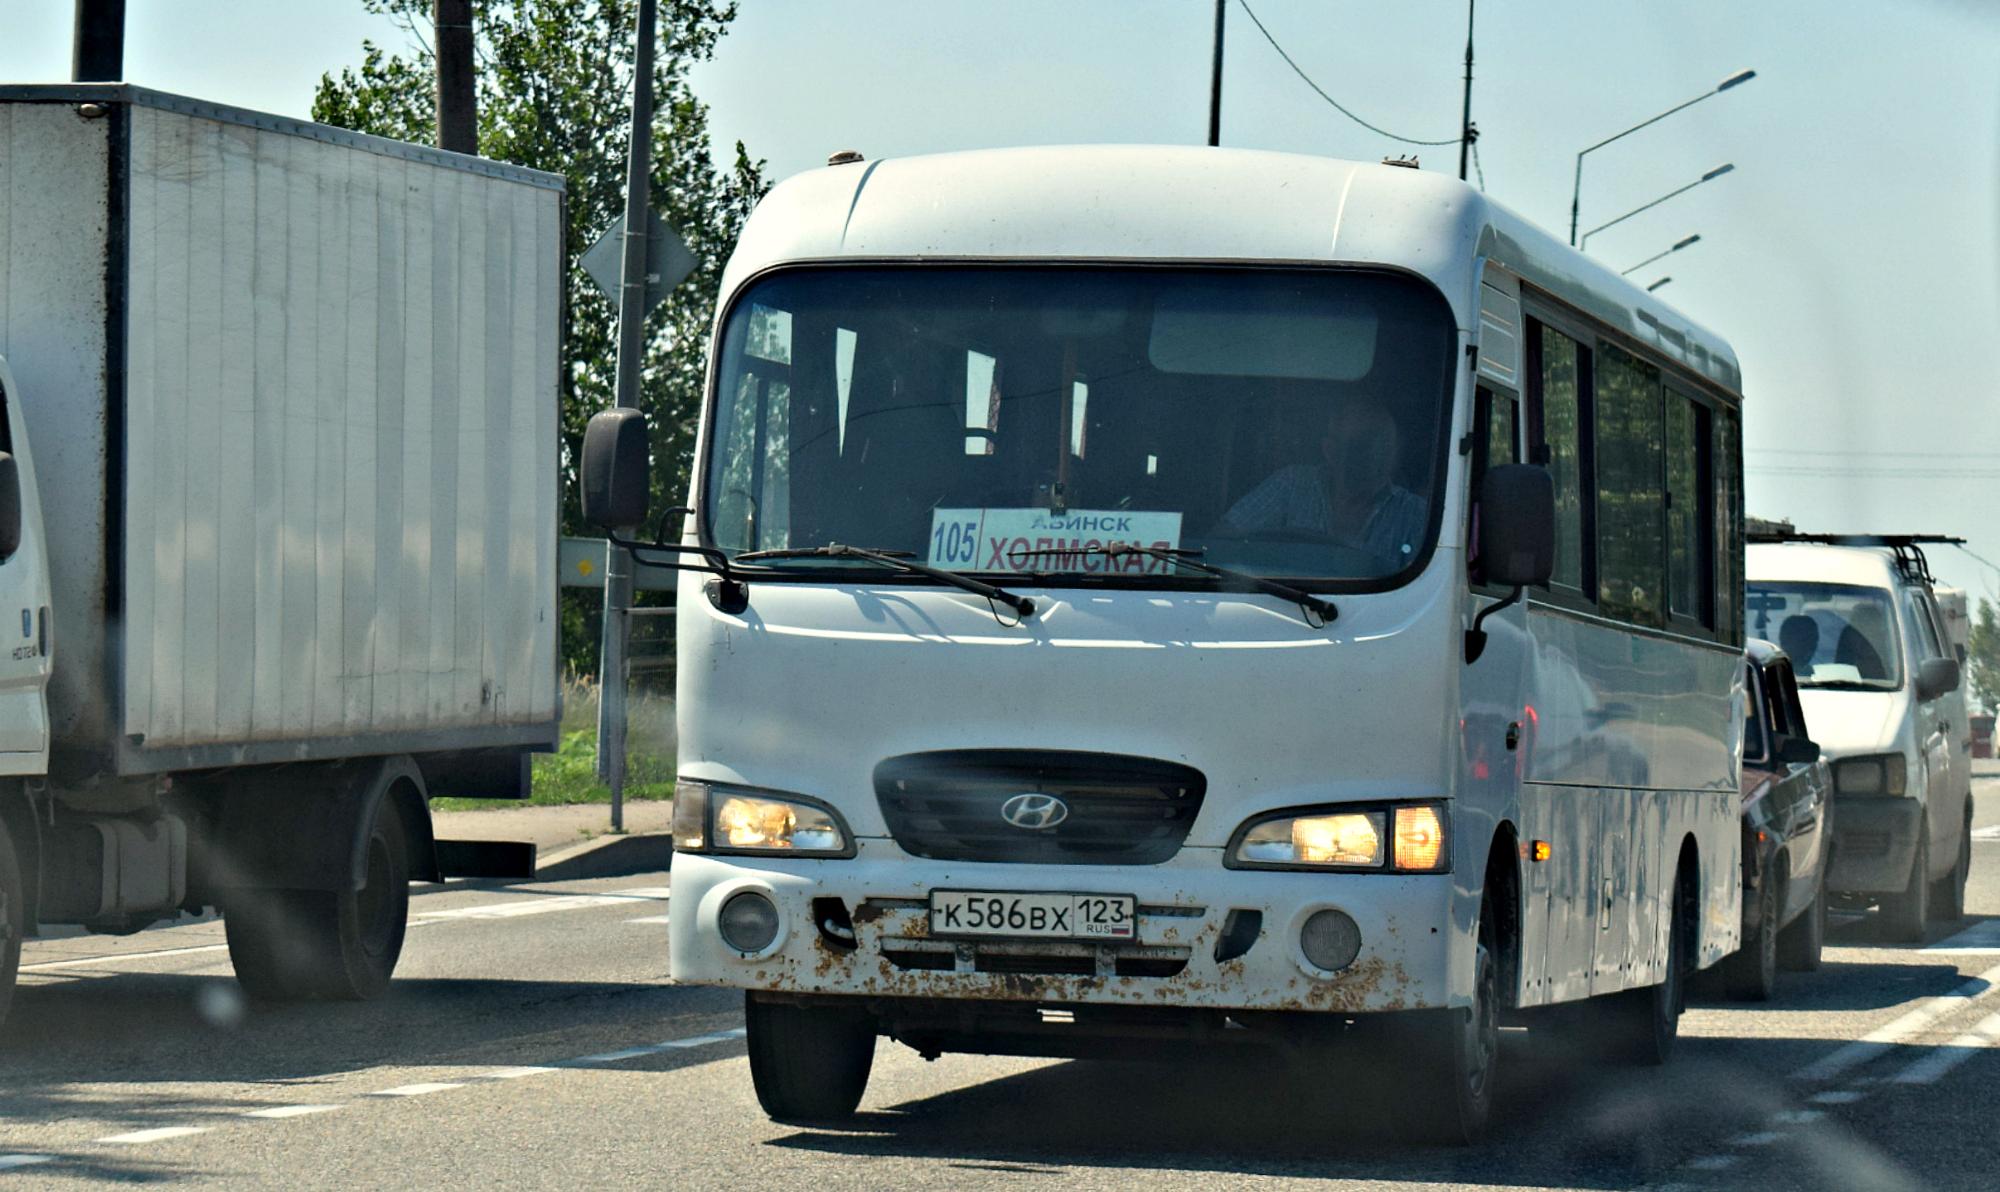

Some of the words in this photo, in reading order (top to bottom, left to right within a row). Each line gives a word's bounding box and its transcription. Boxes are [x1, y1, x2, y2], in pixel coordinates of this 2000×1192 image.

[934, 521, 976, 562] 105
[986, 537, 1170, 574] ХОЛМСКАЯ
[1078, 900, 1124, 923] 123
[1086, 924, 1111, 934] RUS
